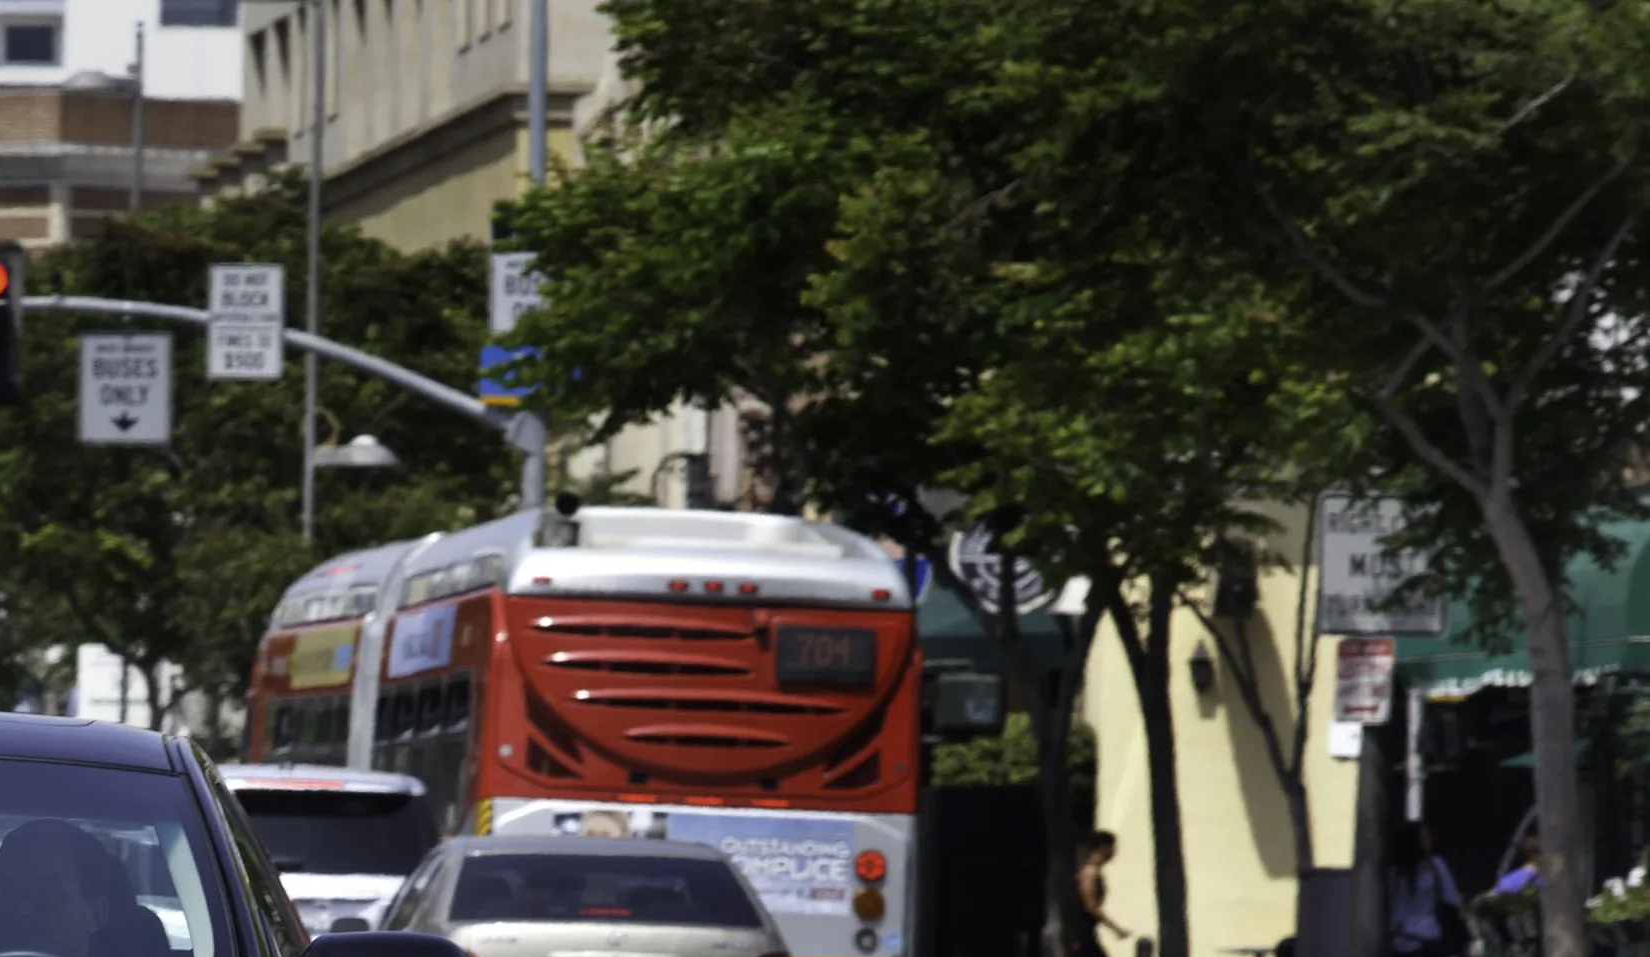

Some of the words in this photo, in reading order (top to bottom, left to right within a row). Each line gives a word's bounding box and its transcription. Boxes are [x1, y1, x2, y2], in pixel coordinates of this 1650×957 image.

[221, 290, 269, 306] BLOCK
[93, 358, 159, 379] BUSES
[99, 384, 151, 407] ONLY
[795, 633, 852, 667] 704
